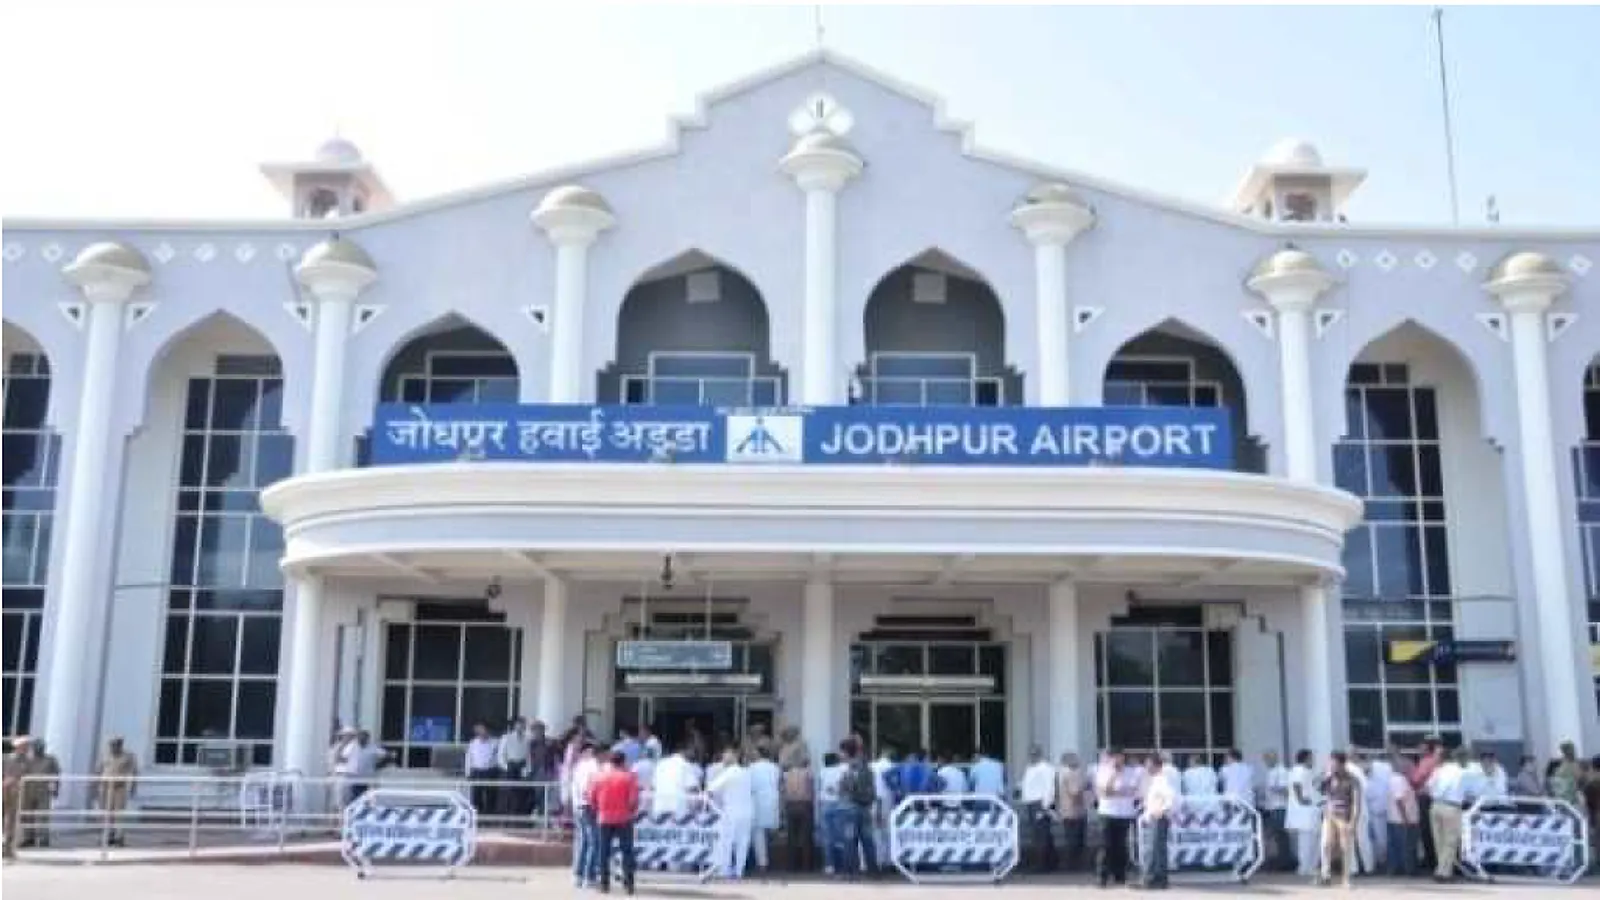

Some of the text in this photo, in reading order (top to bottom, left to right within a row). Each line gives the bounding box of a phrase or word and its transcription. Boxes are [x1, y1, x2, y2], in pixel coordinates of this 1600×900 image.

[517, 408, 604, 459] हवाई
[820, 424, 1216, 456] JODHPUR AIRPORT
